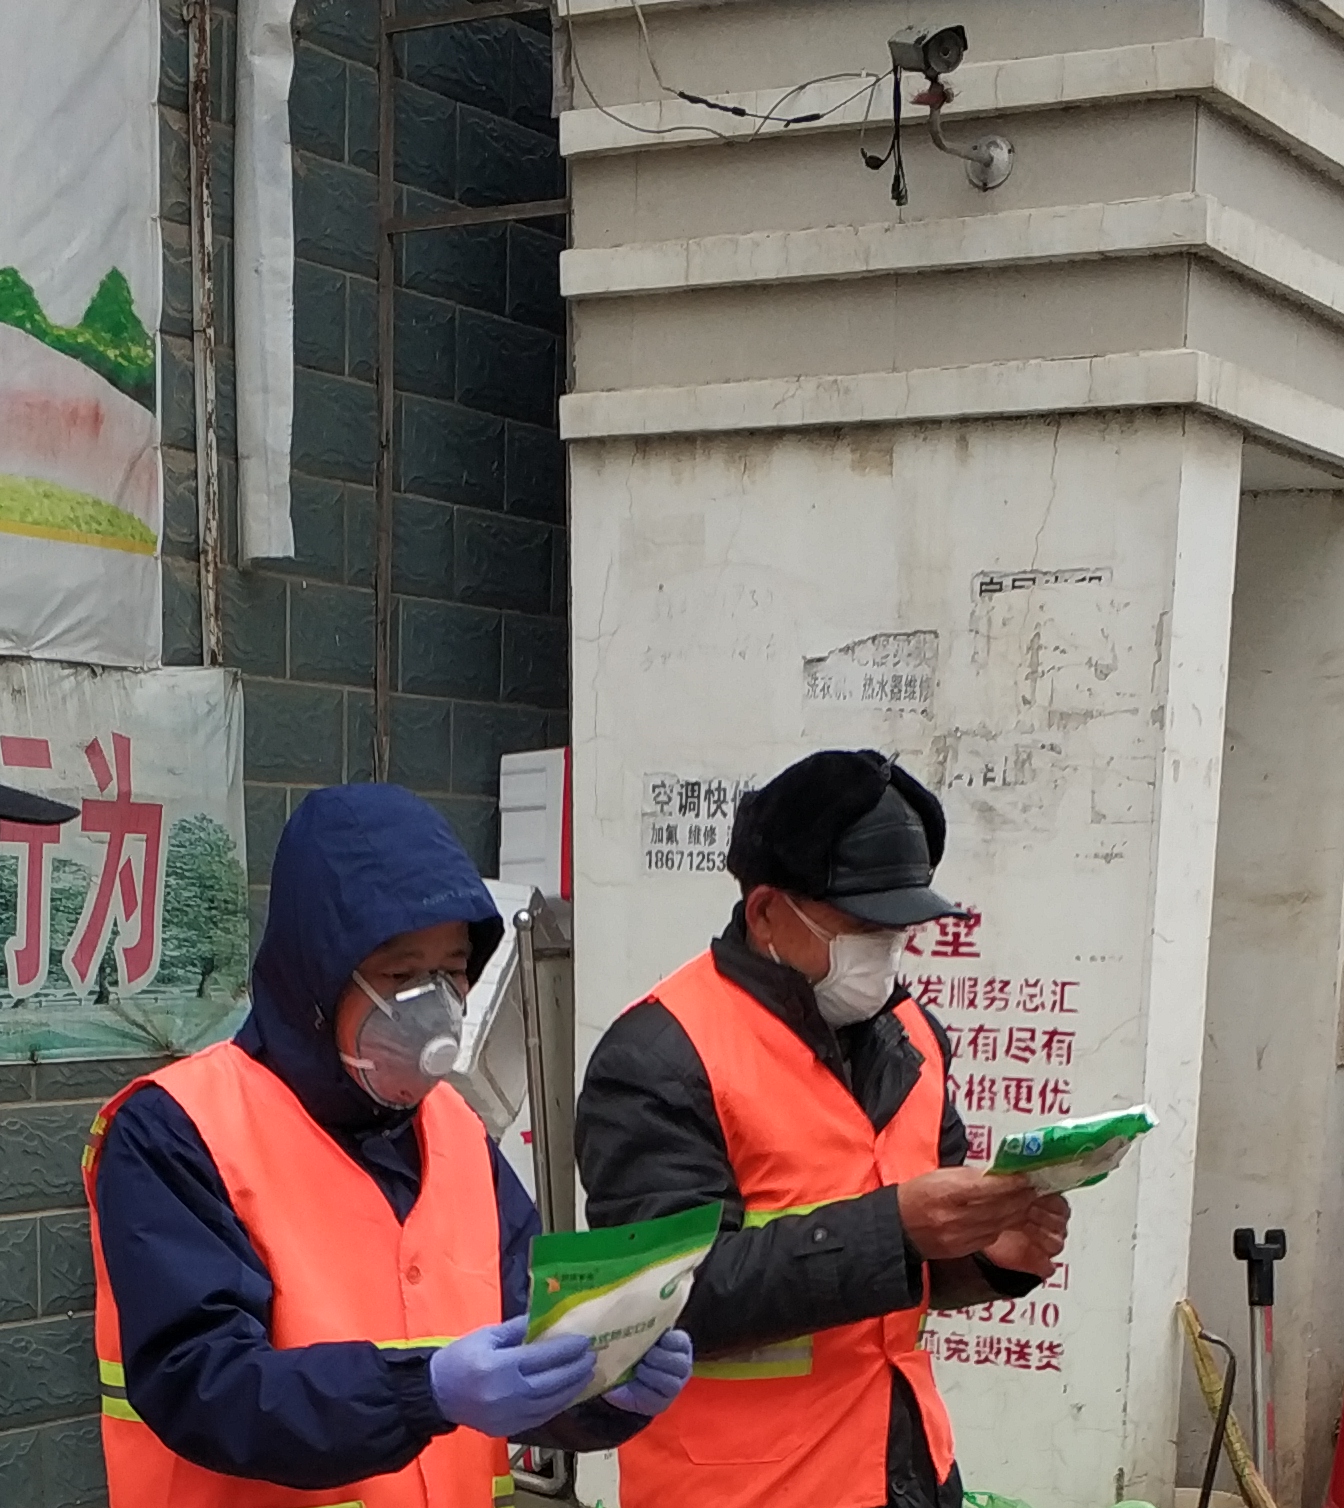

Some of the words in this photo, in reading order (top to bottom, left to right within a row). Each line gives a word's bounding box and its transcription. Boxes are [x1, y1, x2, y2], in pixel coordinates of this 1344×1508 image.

[651, 779, 743, 819] 空调快
[645, 848, 727, 873] 18671253
